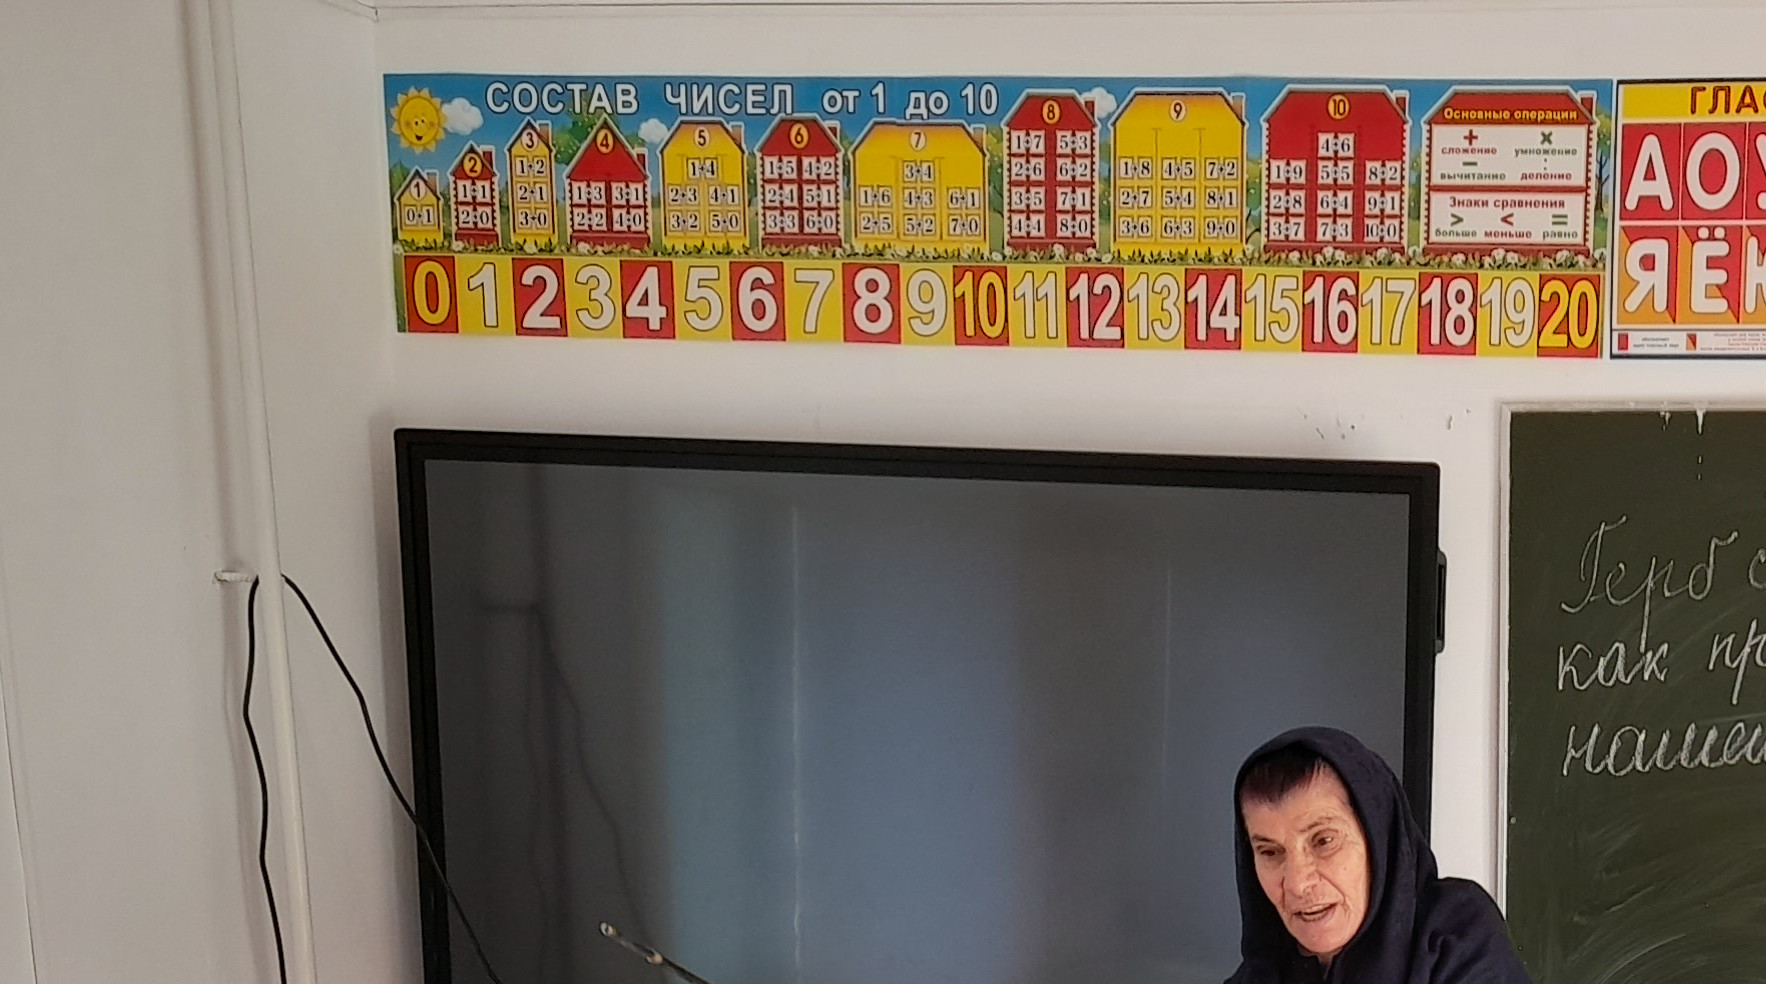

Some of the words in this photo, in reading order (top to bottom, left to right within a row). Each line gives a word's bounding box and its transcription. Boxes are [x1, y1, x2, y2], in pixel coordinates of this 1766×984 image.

[486, 82, 639, 114] СОСТАВ
[665, 83, 793, 114] ЧИСЕЛ
[822, 88, 860, 113] от
[870, 82, 886, 113] 1
[906, 90, 949, 119] до
[961, 83, 998, 116] 10
[1332, 98, 1347, 116] 10
[1046, 104, 1055, 120] 8
[1173, 102, 1182, 119] 9
[1444, 108, 1510, 120] Основные
[1514, 110, 1577, 122] операции
[526, 133, 535, 149] 3
[600, 133, 610, 153] 4
[697, 129, 707, 145] 5
[795, 126, 804, 144] 6
[914, 131, 922, 149] 7
[1515, 149, 1577, 158] умножение
[467, 157, 478, 174] 2
[1520, 173, 1572, 181] деление
[414, 182, 422, 197] 1
[1450, 197, 1488, 208] Знаки
[1494, 199, 1565, 210] сравнения
[1435, 229, 1477, 238] больше
[1542, 231, 1578, 240] равно
[413, 261, 451, 325] 0
[467, 262, 498, 328] 1
[521, 264, 561, 329] 2
[576, 264, 616, 330] 3
[625, 266, 667, 331] 4
[684, 266, 723, 331] 5
[737, 266, 778, 333] 6
[794, 268, 834, 334] 7
[853, 267, 893, 335] 8
[907, 269, 948, 337] 9
[954, 270, 1006, 339] 10
[1014, 271, 1059, 339] 11
[1068, 272, 1121, 340] 12
[1127, 272, 1180, 341] 13
[1186, 274, 1239, 342] 14
[1245, 274, 1300, 342] 15
[1304, 275, 1357, 345] 16
[1361, 276, 1416, 346] 17
[1420, 276, 1475, 347] 18
[1480, 277, 1536, 348] 19
[1539, 278, 1598, 349] 20
[1560, 515, 1739, 654] Герб
[1557, 639, 1669, 690] как
